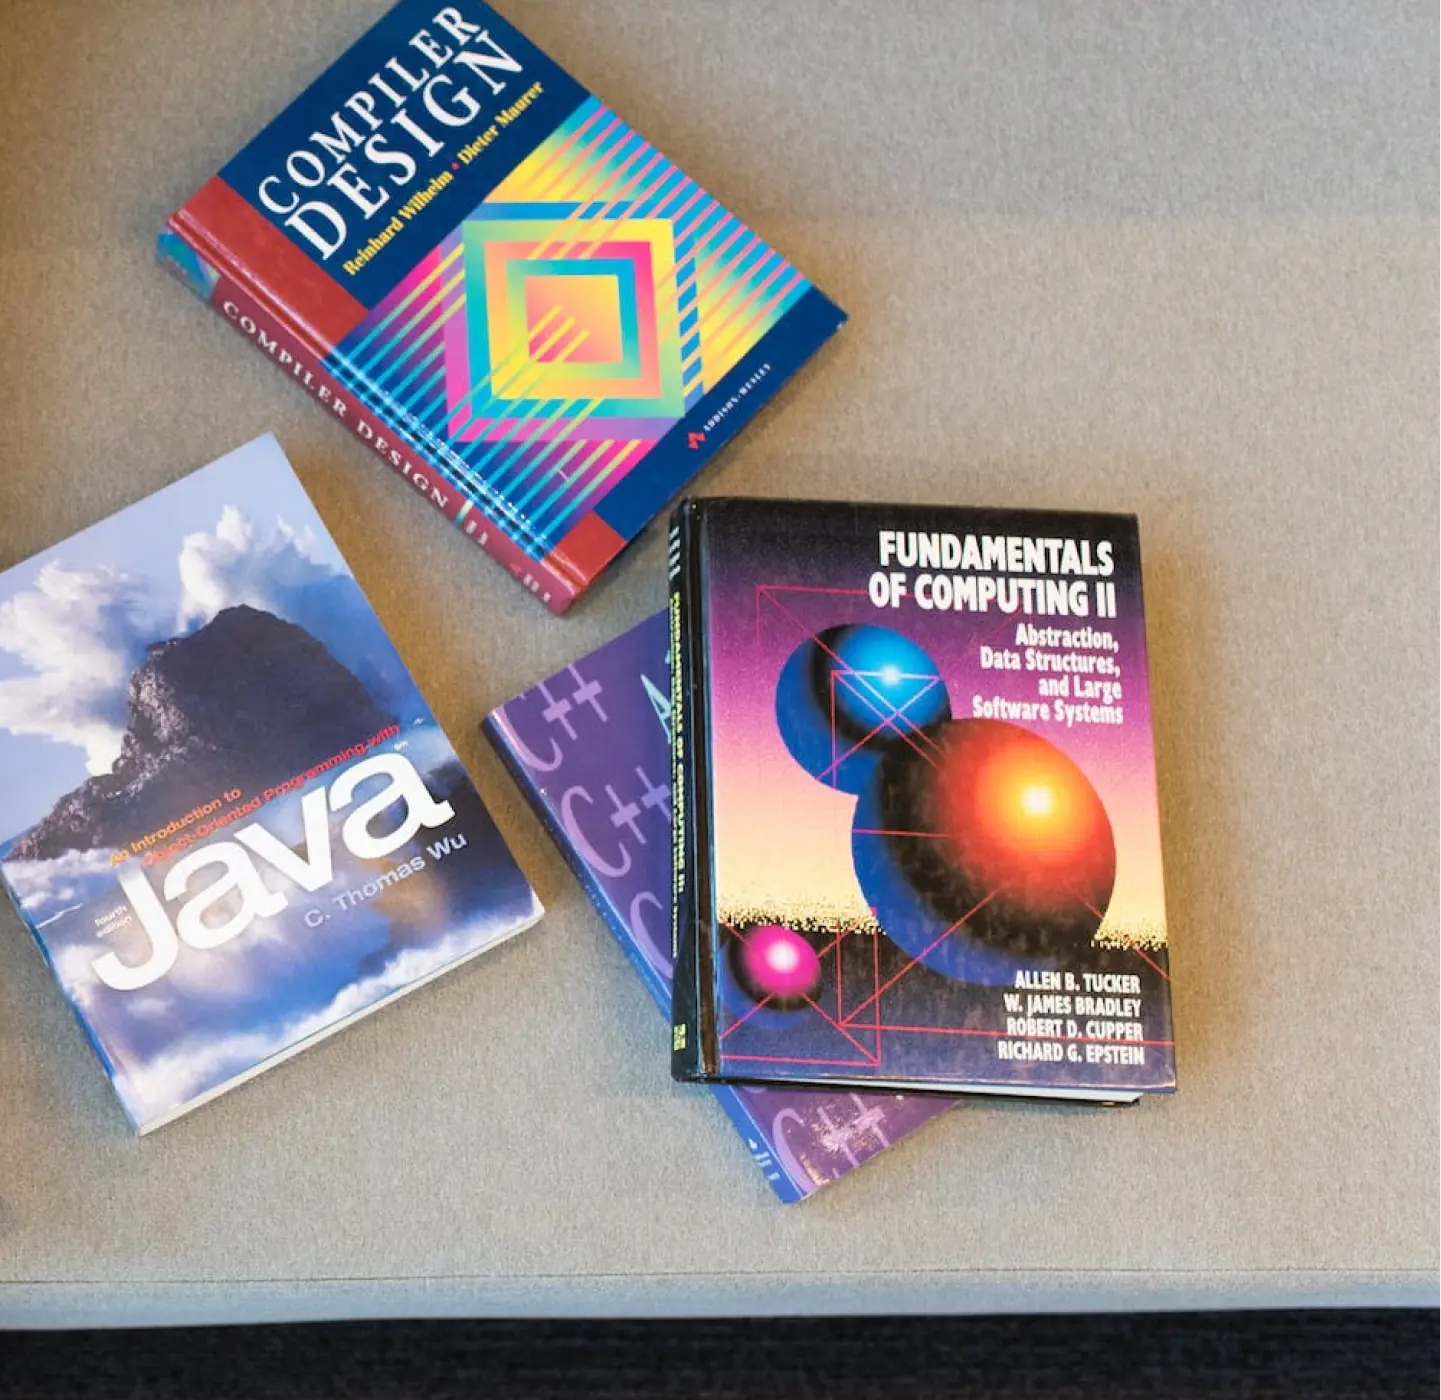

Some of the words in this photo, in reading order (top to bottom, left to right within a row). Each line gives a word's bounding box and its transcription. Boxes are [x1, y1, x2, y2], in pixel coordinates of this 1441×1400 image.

[259, 6, 481, 215] COMPILER
[284, 29, 523, 260] DESIGN
[343, 217, 404, 276] Reinhard
[398, 169, 454, 221] Wilhelm
[457, 125, 499, 165] Dieter
[495, 81, 544, 128] Maurer
[223, 301, 348, 417] COMPILER
[356, 420, 448, 509] DESIGN
[878, 531, 1115, 576] FUNDAMENTALS
[868, 572, 907, 608] OF
[914, 573, 1089, 617] COMPUTING
[1096, 581, 1117, 618] II
[1016, 624, 1119, 652] Abstraction,
[980, 646, 1021, 671] Data
[1025, 648, 1120, 677] Structures,
[972, 696, 1050, 720] Software
[1054, 699, 1124, 728] Systems
[1039, 676, 1071, 698] and
[1074, 675, 1122, 704] Large
[263, 740, 368, 803] Programming
[367, 724, 400, 747] with
[131, 799, 222, 853] Introduction
[224, 787, 242, 802] to
[91, 752, 455, 991] Java
[304, 908, 331, 928] C.
[334, 855, 426, 912] Thomas
[426, 832, 467, 861] Wu
[1014, 970, 1060, 991] ALLEN
[1064, 972, 1080, 992] B.
[1083, 973, 1141, 994] TUCKER
[1003, 993, 1023, 1012] W.
[1027, 994, 1072, 1017] JAMES
[1075, 997, 1142, 1018] BRADLEY
[1006, 1017, 1063, 1038] ROBERT
[1066, 1020, 1082, 1039] D.
[1086, 1020, 1143, 1041] CUPPER
[998, 1041, 1064, 1062] RICHARD
[1066, 1043, 1082, 1063] G.
[1086, 1044, 1145, 1065] EPSTEIN
